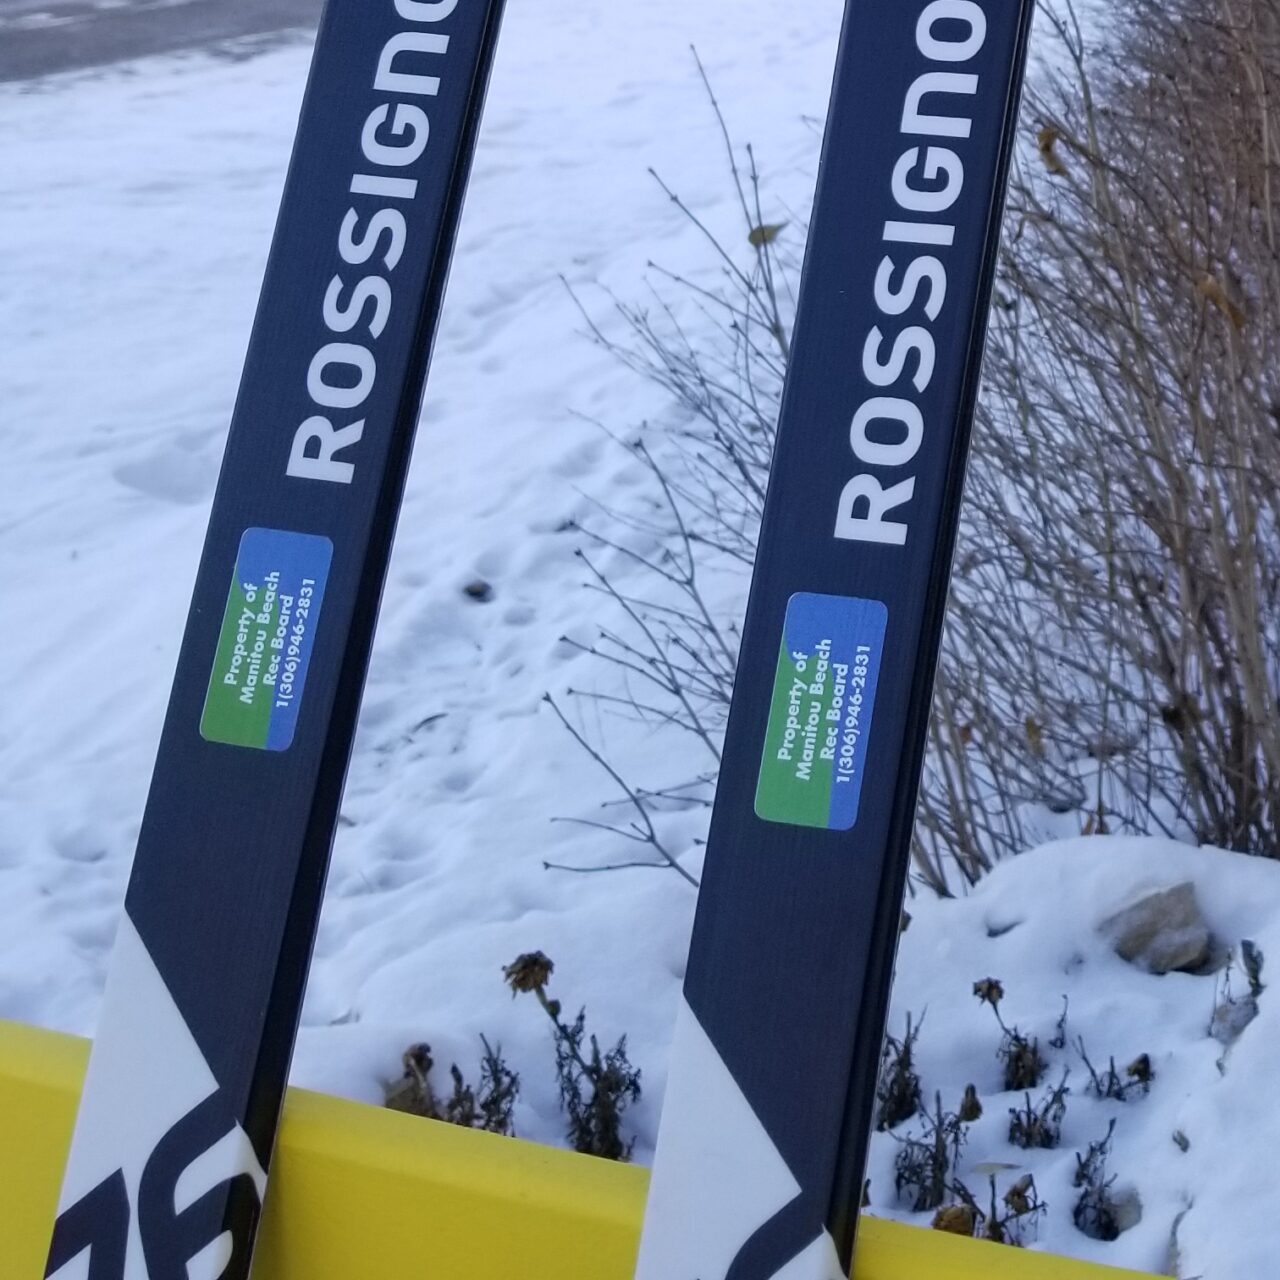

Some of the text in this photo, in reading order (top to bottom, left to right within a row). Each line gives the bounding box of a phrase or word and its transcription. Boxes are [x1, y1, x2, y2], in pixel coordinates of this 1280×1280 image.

[224, 583, 258, 685] Property of
[239, 571, 281, 705] Manitou Beach
[263, 594, 294, 686] Rec Board
[275, 578, 316, 707] 1(306)946-2831
[777, 651, 808, 761] Property of
[795, 638, 832, 781] Manitou Beach
[820, 663, 849, 761] Rec Board
[836, 645, 871, 783] 1(306)946-2831
